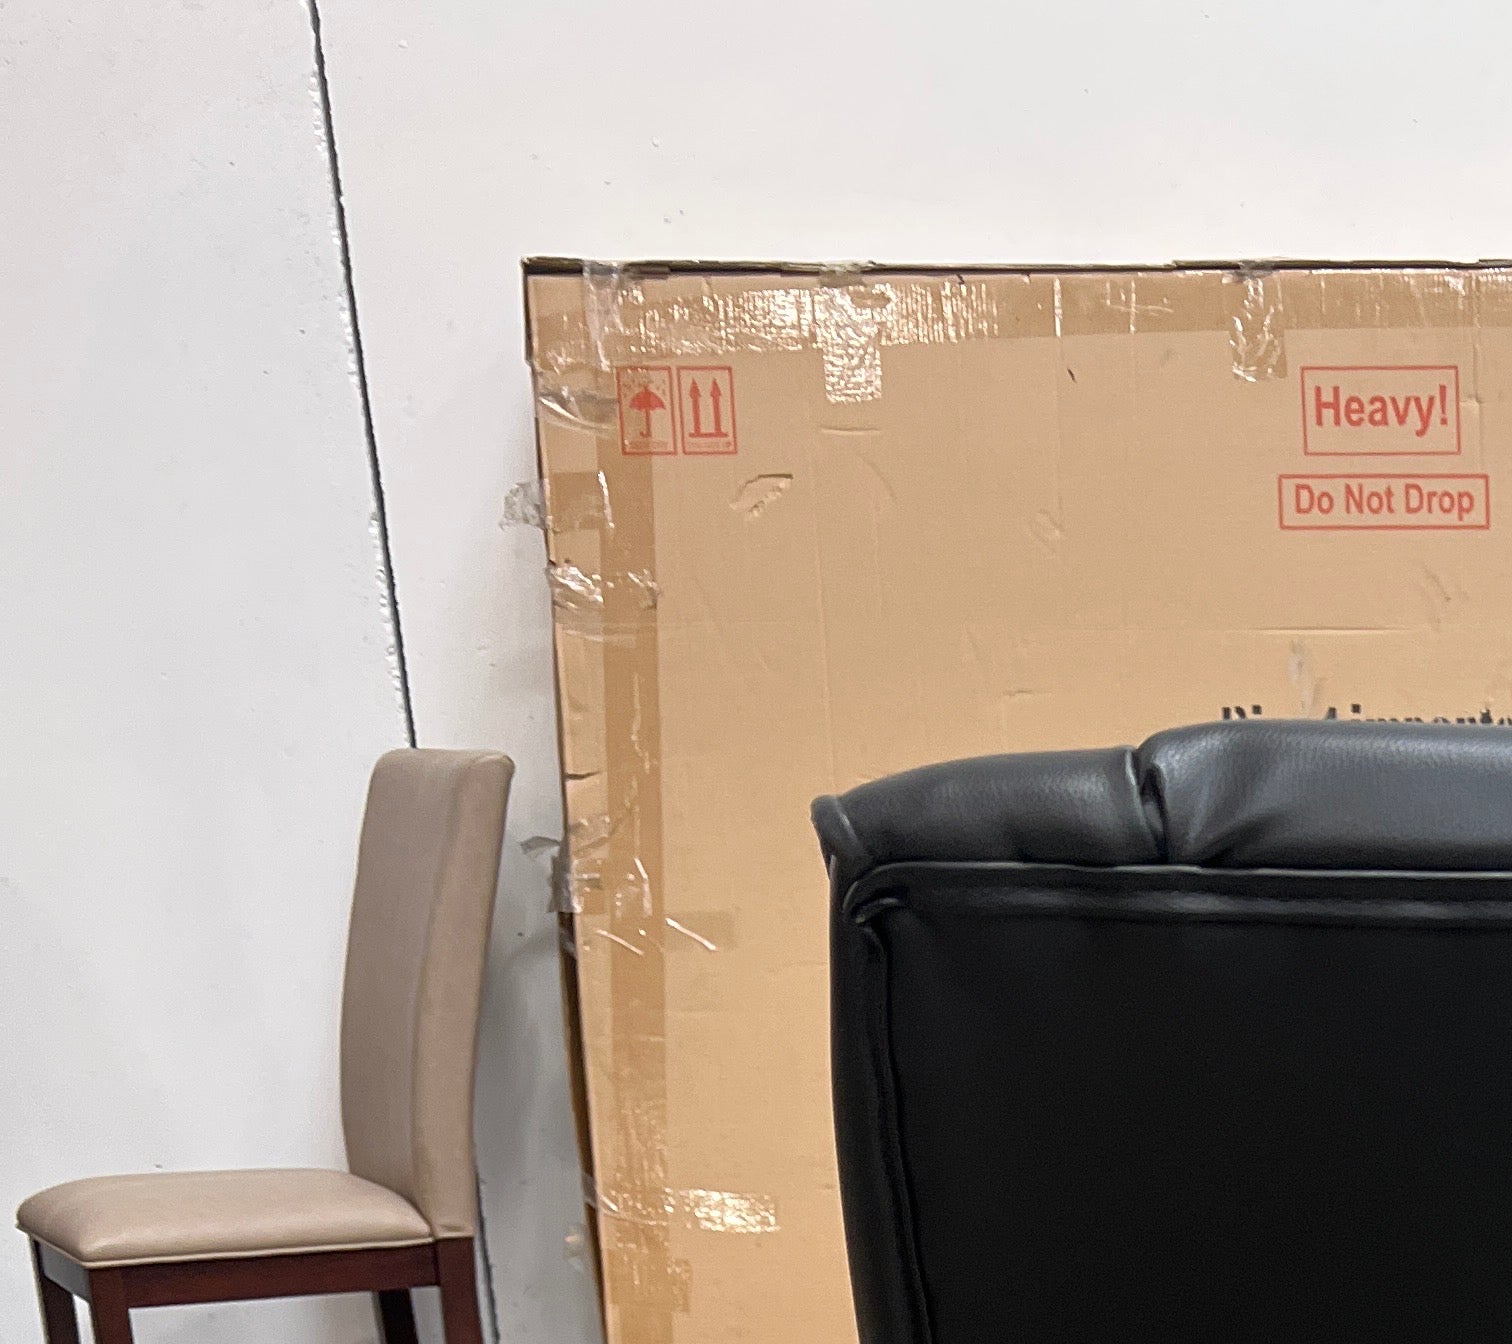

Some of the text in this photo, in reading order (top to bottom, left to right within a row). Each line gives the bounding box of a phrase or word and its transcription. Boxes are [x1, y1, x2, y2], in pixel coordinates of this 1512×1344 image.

[1314, 384, 1449, 437] Heavy!
[1294, 483, 1476, 521] Do Not Drop
